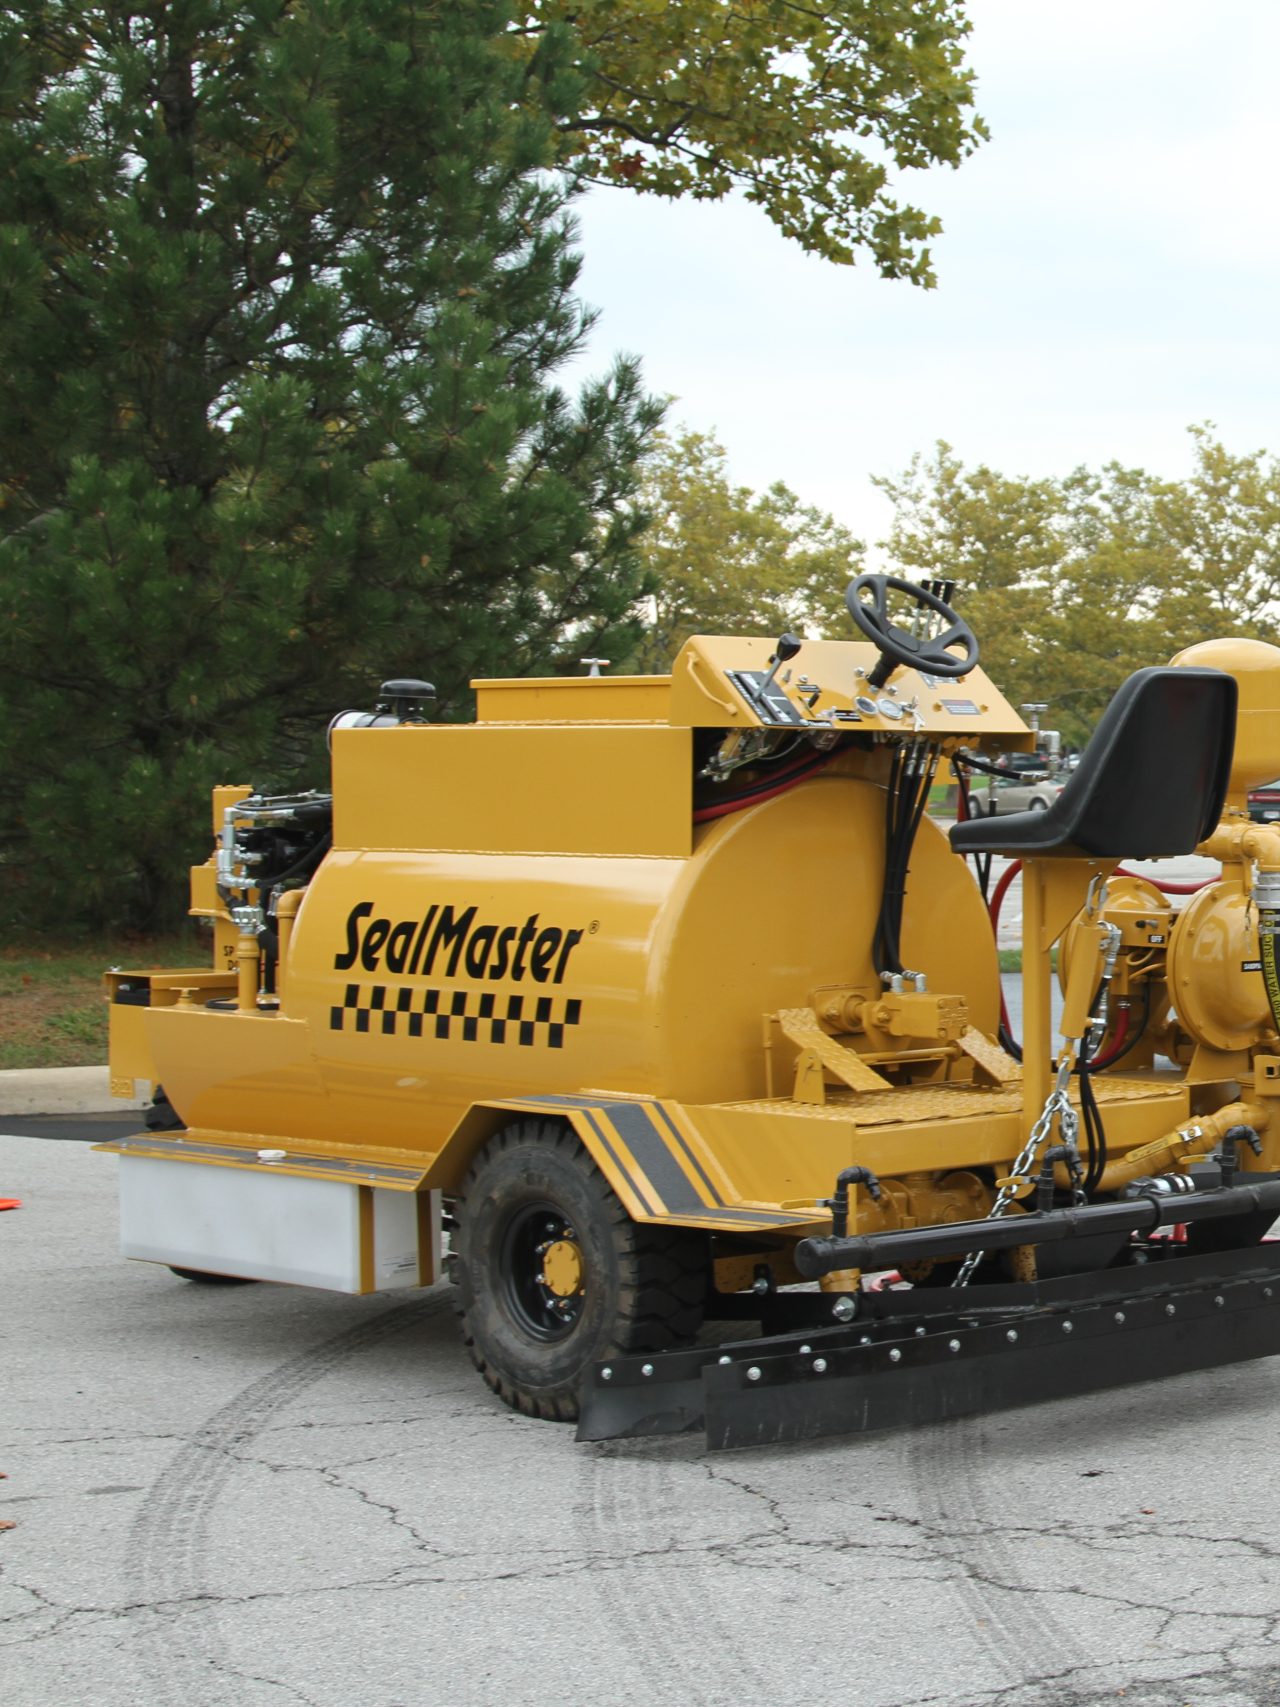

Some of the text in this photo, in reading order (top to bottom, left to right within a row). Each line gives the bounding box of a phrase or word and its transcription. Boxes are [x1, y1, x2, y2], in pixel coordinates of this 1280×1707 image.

[334, 902, 584, 984] SealMaster
[1263, 911, 1274, 958] SUCO
[1267, 959, 1280, 998] WATER
